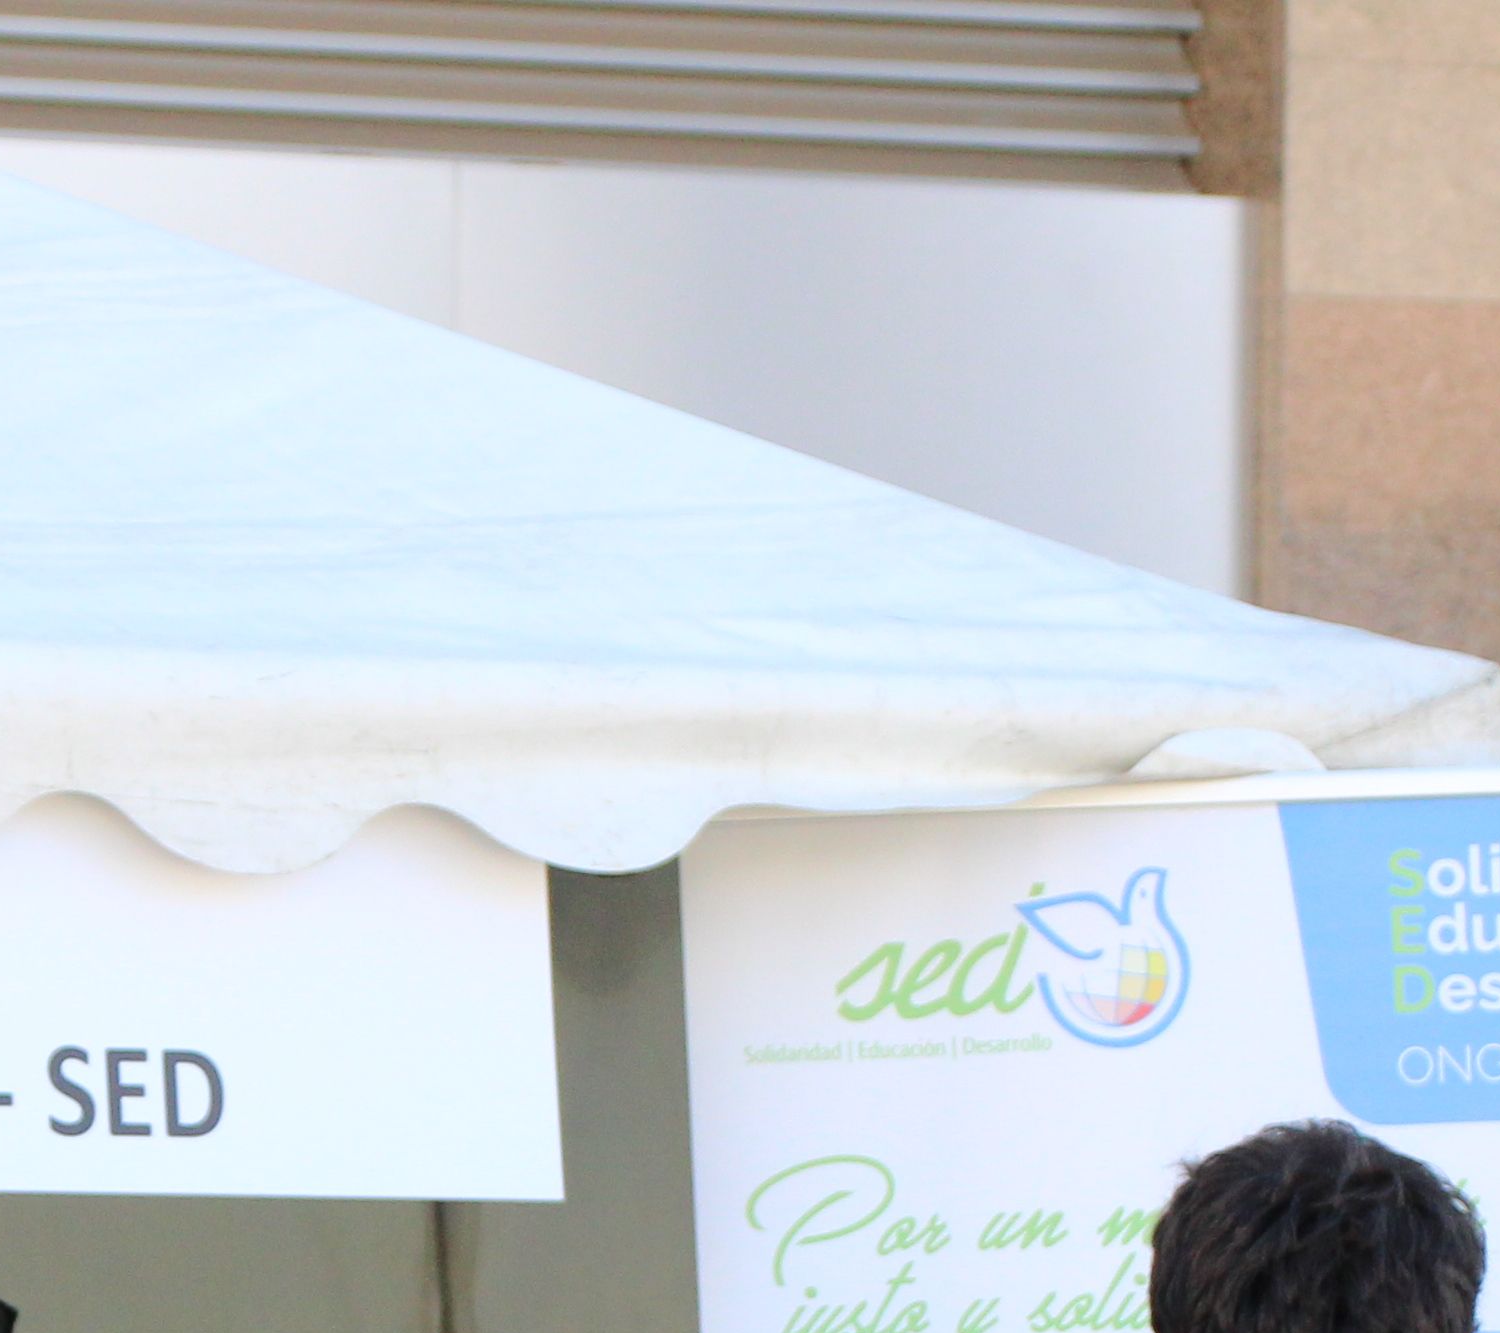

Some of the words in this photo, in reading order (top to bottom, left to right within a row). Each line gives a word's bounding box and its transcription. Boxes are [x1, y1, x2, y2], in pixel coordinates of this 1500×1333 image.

[46, 1045, 226, 1139] SED
[745, 1154, 951, 1286] Por
[977, 1207, 1069, 1251] un
[1026, 1252, 1151, 1333] soli
